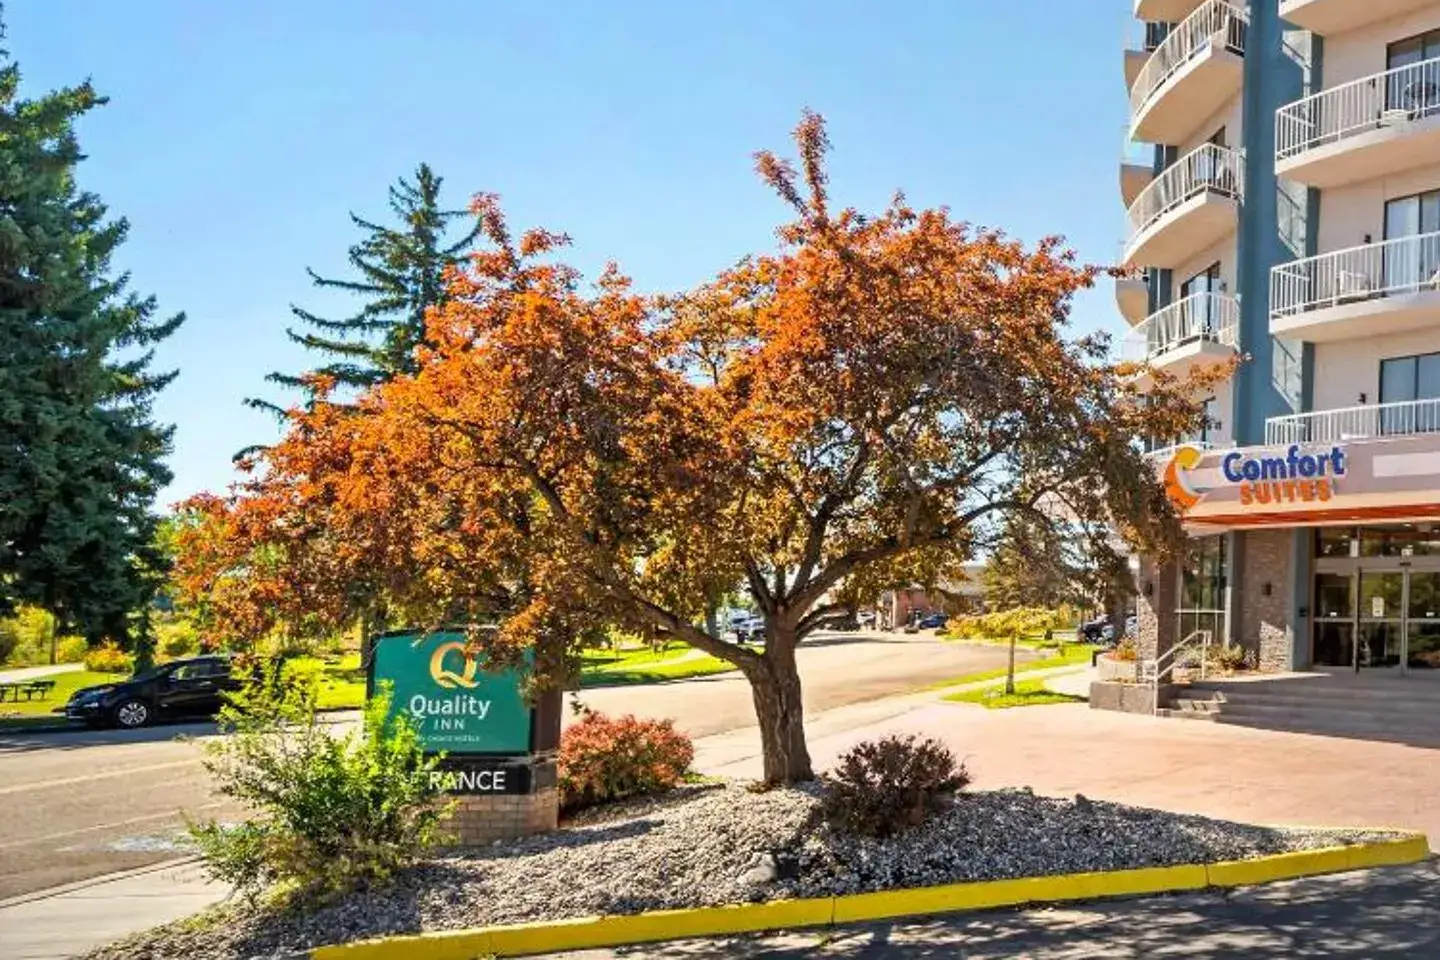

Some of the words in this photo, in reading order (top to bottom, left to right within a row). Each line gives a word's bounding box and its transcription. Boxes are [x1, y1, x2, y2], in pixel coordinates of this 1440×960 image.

[1223, 444, 1346, 483] Comfort
[1240, 478, 1333, 506] SUITES
[430, 641, 480, 689] Q
[410, 694, 491, 720] Quality
[433, 718, 465, 730] INN
